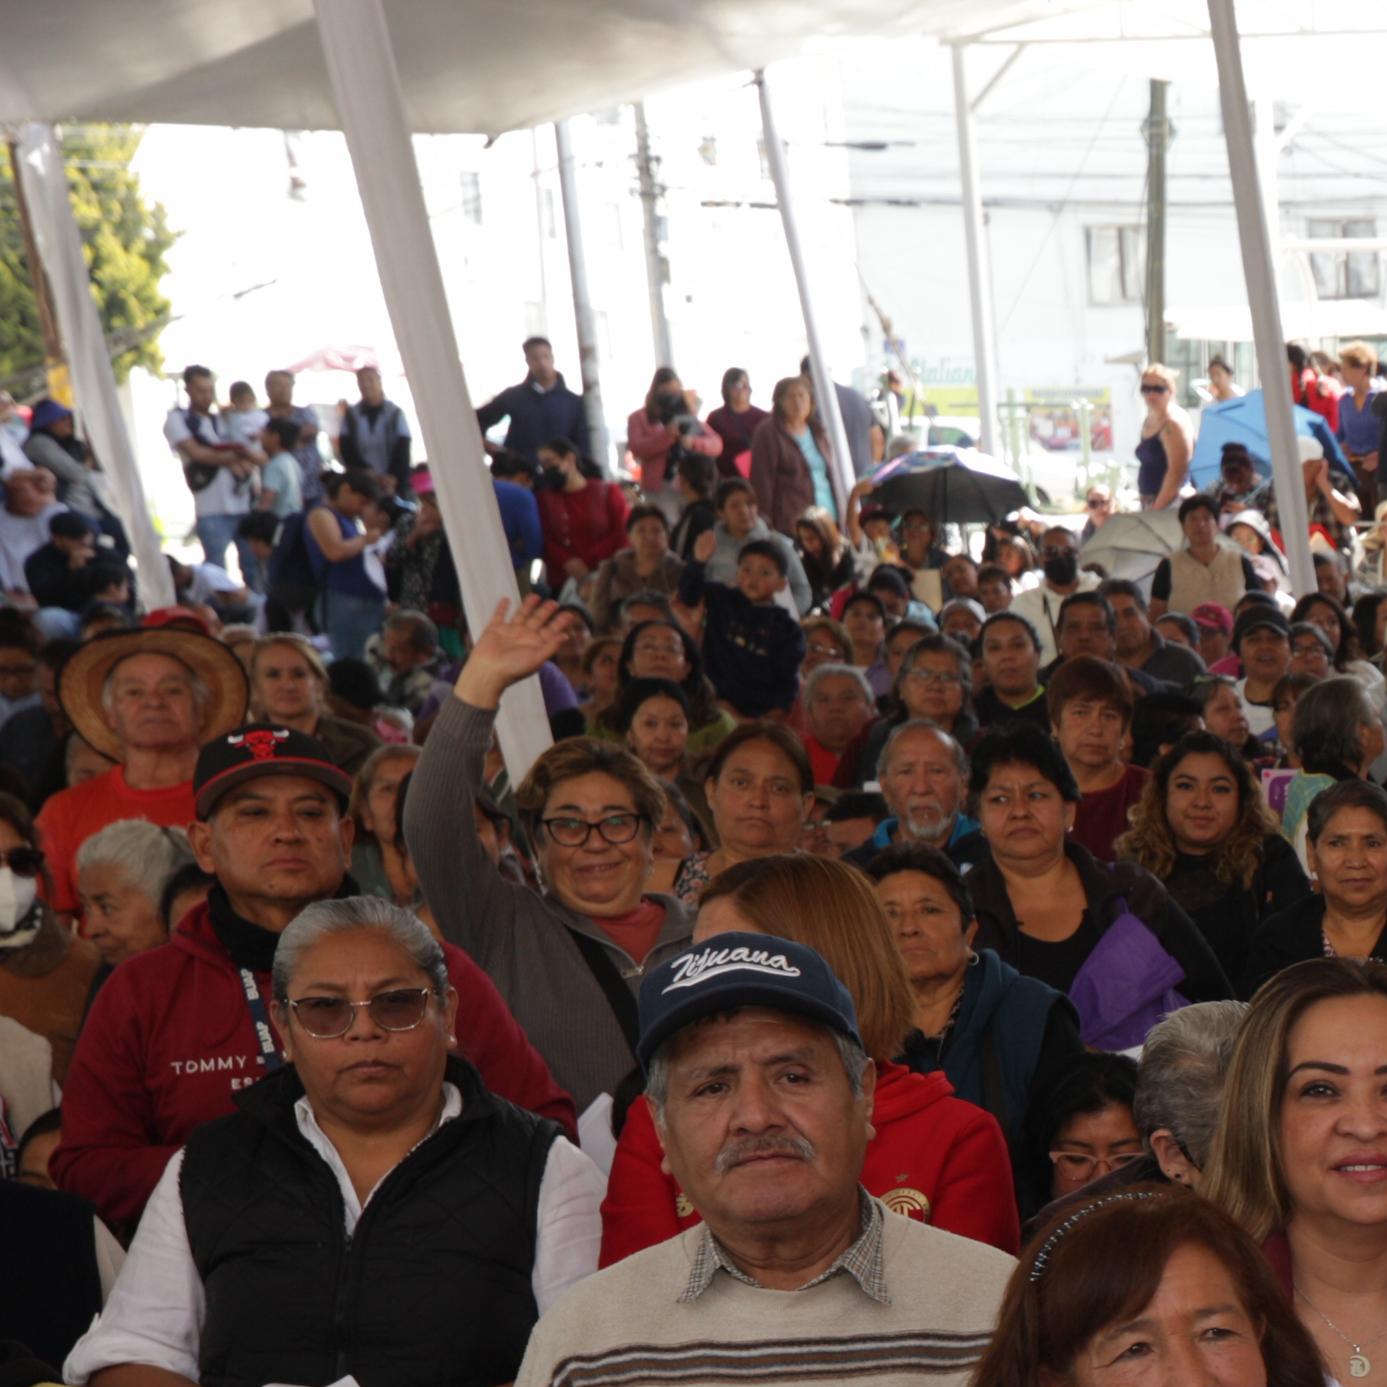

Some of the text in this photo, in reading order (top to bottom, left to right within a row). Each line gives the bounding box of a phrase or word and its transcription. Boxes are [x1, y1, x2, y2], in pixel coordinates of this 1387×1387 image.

[668, 947, 798, 984] Tijuana
[240, 968, 259, 1000] BUAP
[256, 1021, 275, 1053] BUAP
[170, 1056, 246, 1075] TOMMY
